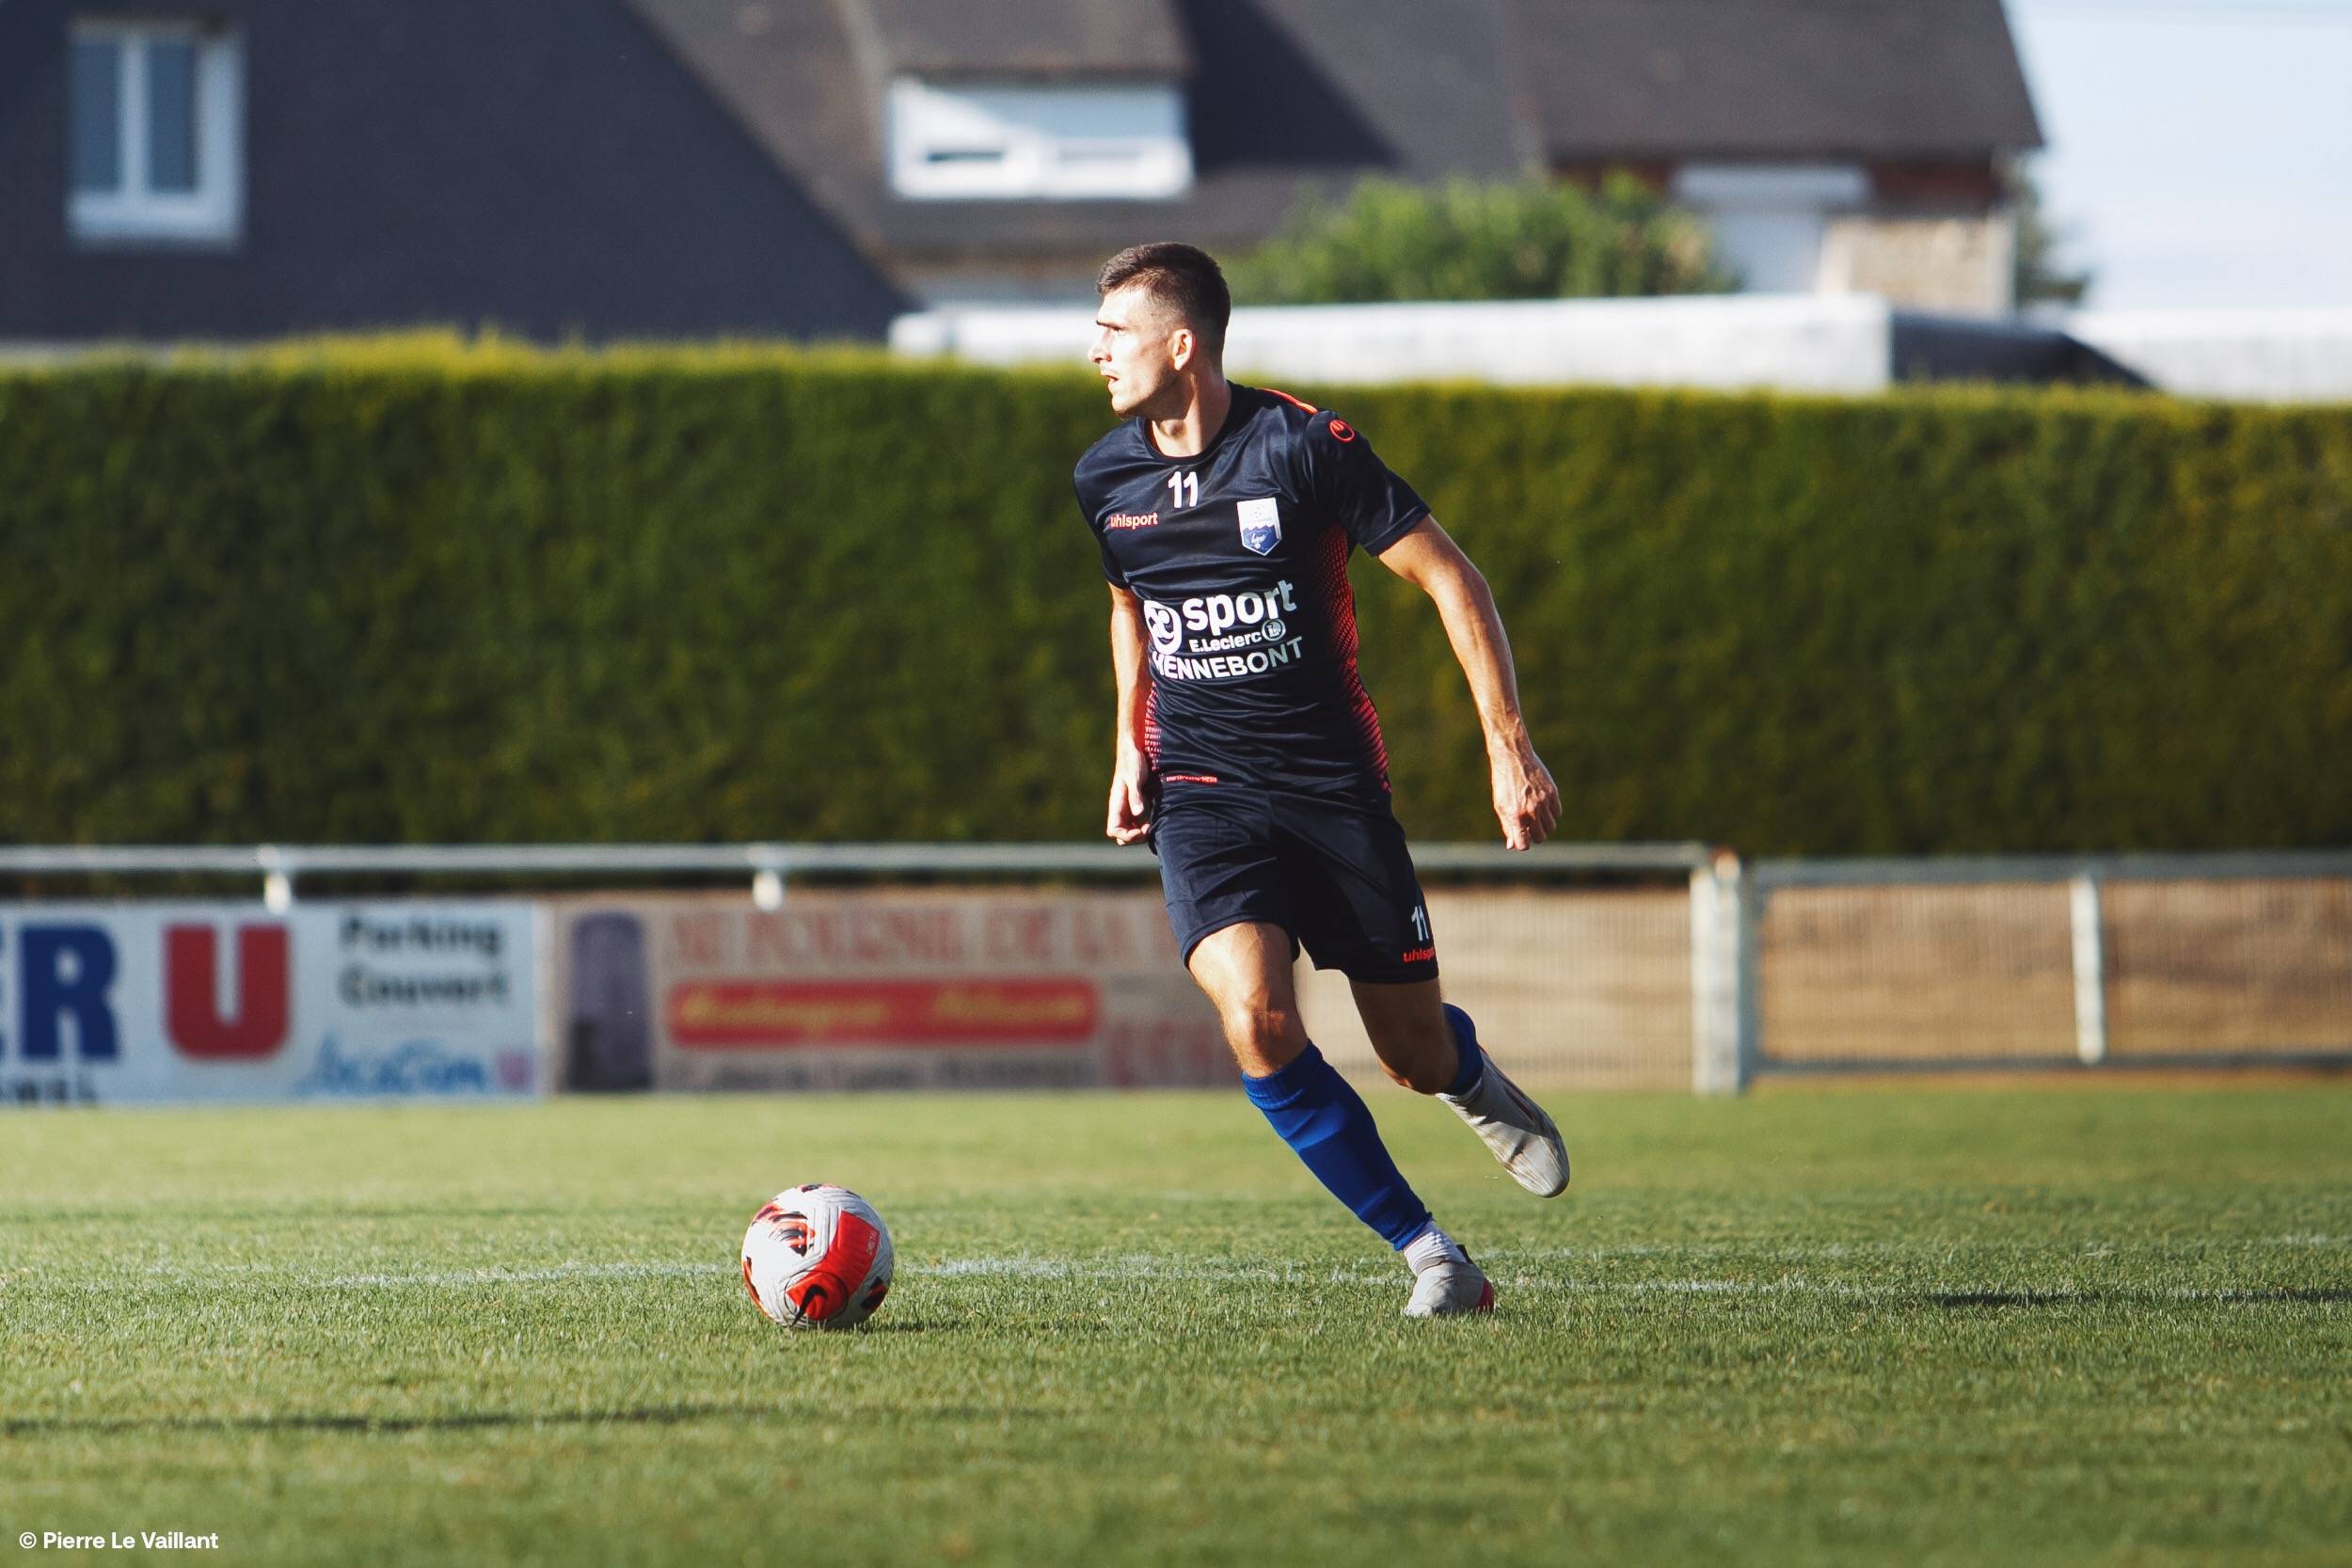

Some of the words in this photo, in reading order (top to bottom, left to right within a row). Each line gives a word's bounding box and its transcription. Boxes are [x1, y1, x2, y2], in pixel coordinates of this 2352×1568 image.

[1168, 471, 1199, 509] 11
[1110, 512, 1158, 530] uhlsport
[1182, 579, 1297, 636] sport
[1152, 636, 1303, 680] HENNEBONT
[1188, 631, 1263, 653] E.Leclerc
[341, 912, 505, 961] Parking
[1411, 905, 1430, 942] 11
[0, 926, 119, 1061] R
[163, 923, 290, 1061] U
[340, 962, 509, 1008] Couvert
